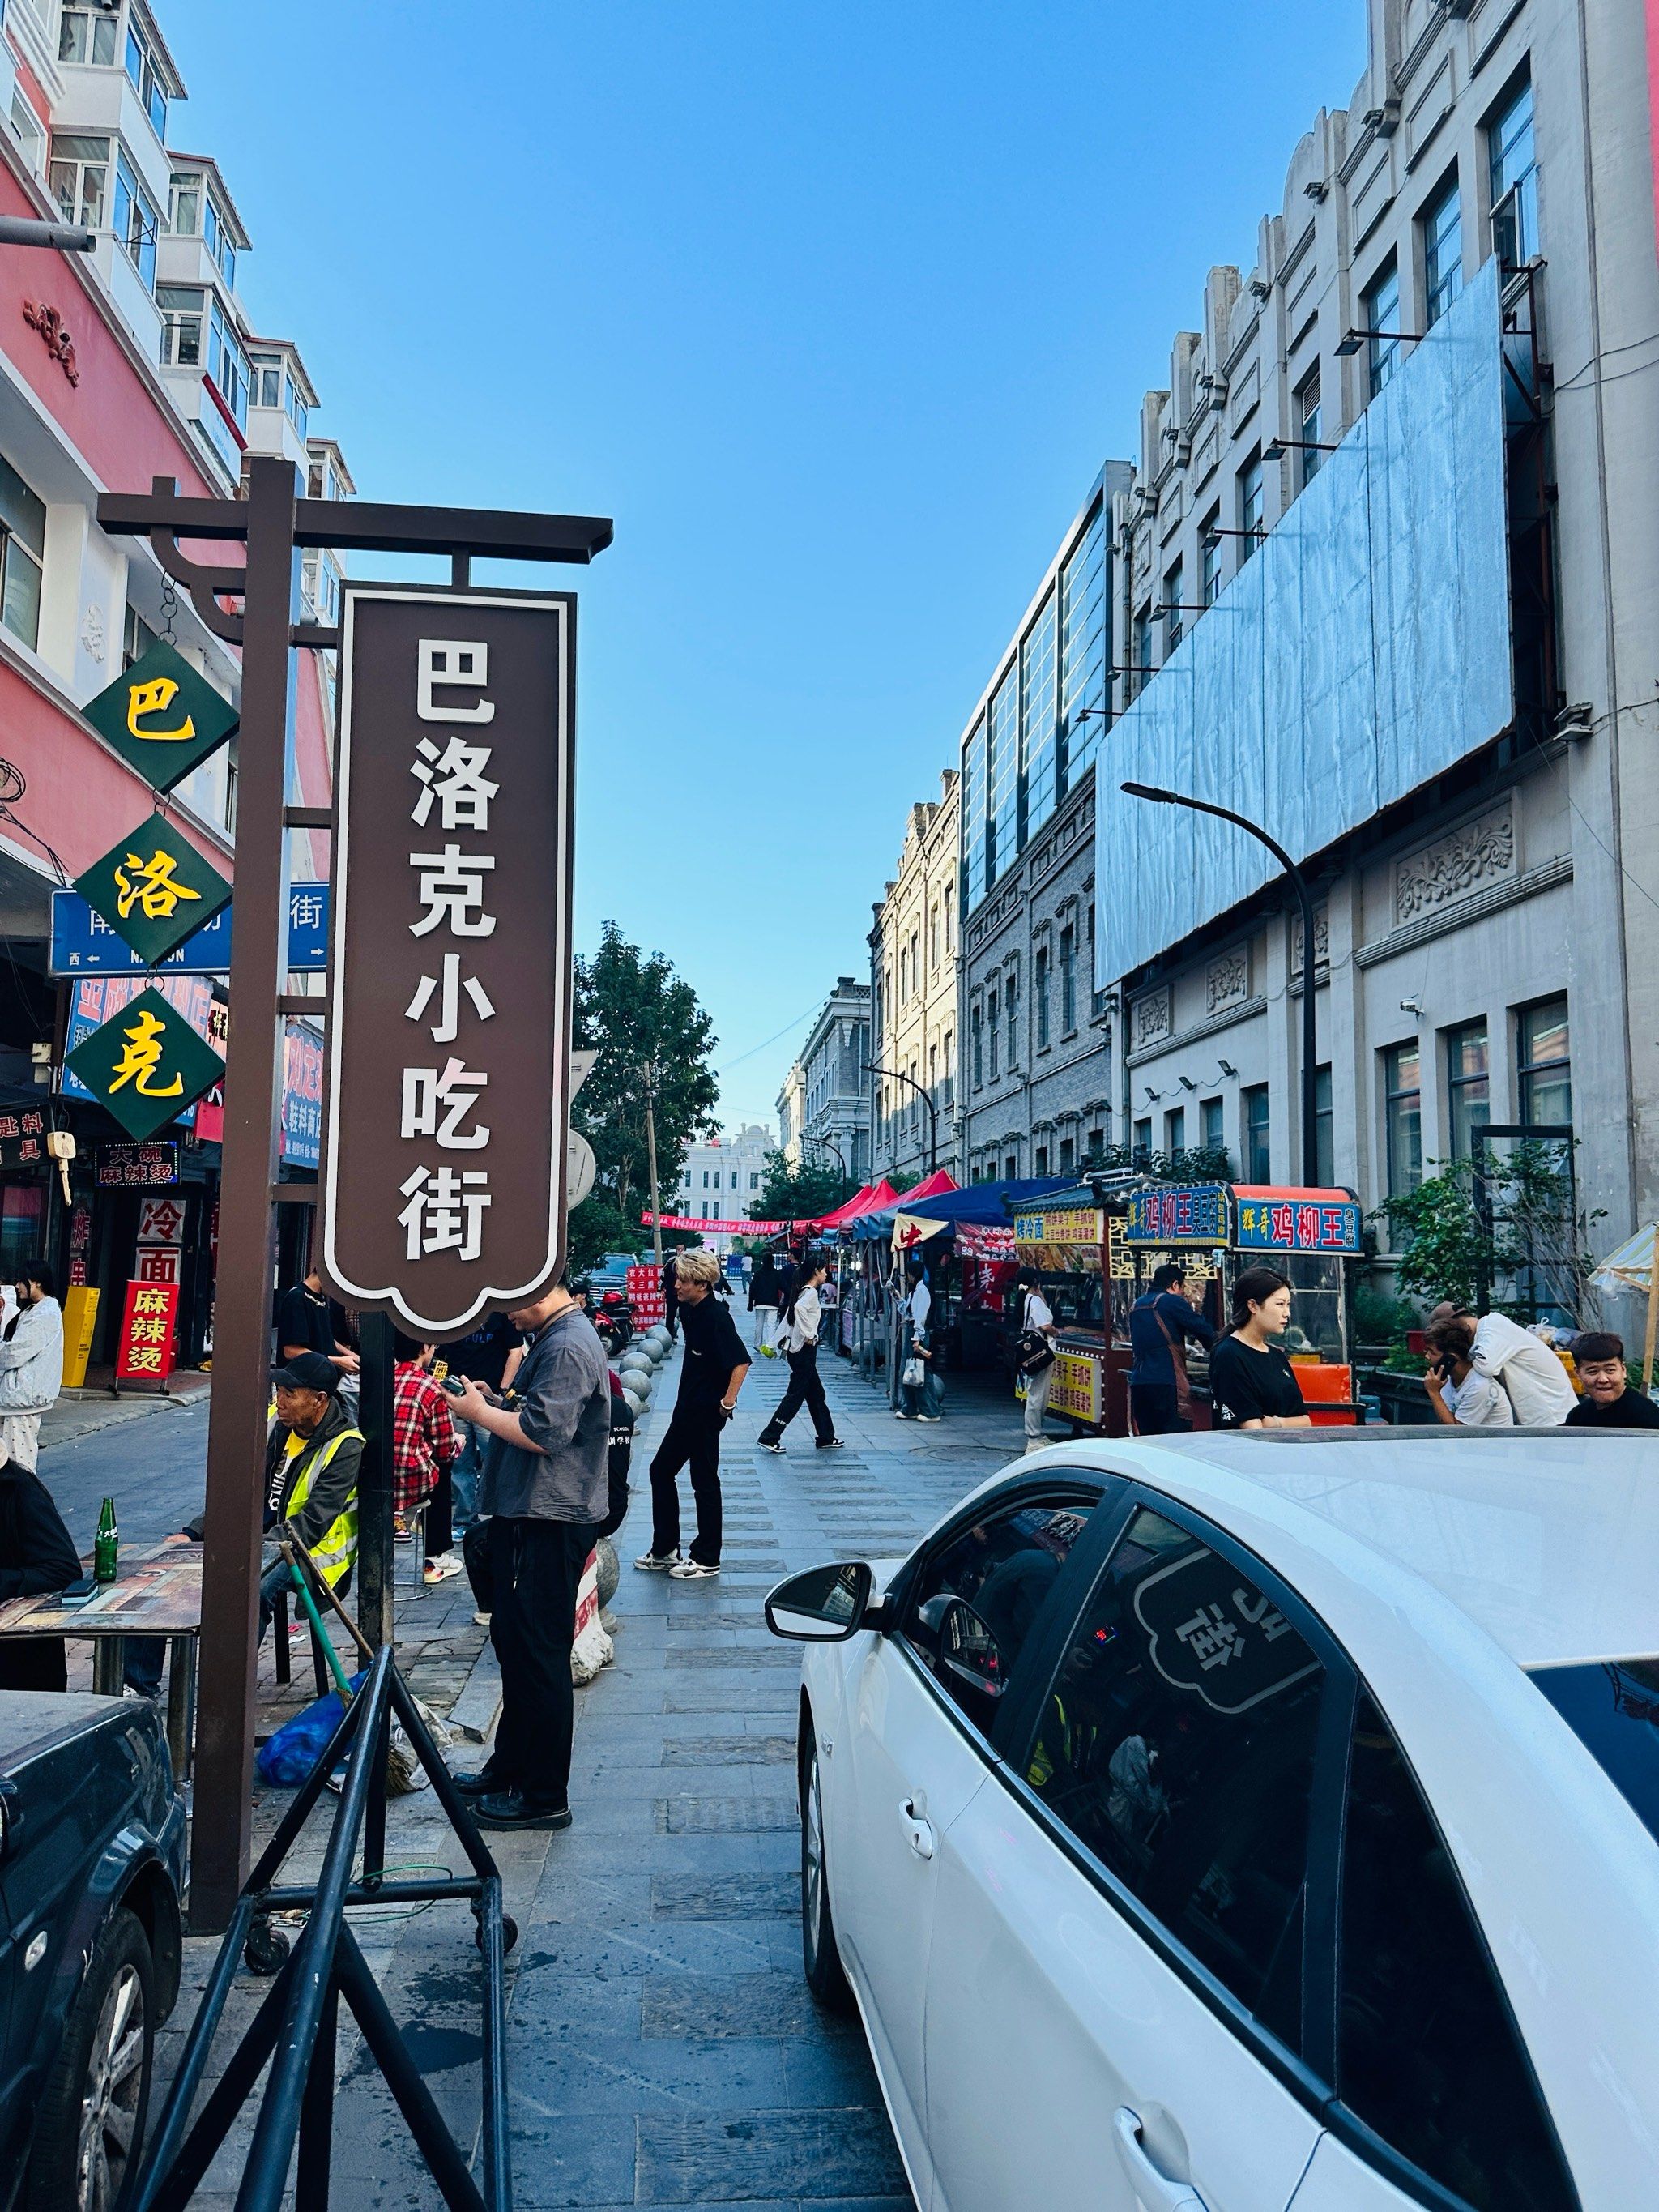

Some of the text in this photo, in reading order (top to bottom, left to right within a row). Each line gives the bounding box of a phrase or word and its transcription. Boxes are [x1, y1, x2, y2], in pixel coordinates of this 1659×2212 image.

[109, 677, 203, 1098] 巴洛克
[69, 953, 80, 967] 西
[398, 638, 500, 1262] 巴洛克小吃街
[99, 1164, 173, 1184] 麻辣烫
[109, 1147, 162, 1164] 大碗
[139, 1200, 184, 1283] 冷面
[126, 1288, 170, 1373] 麻辣烫
